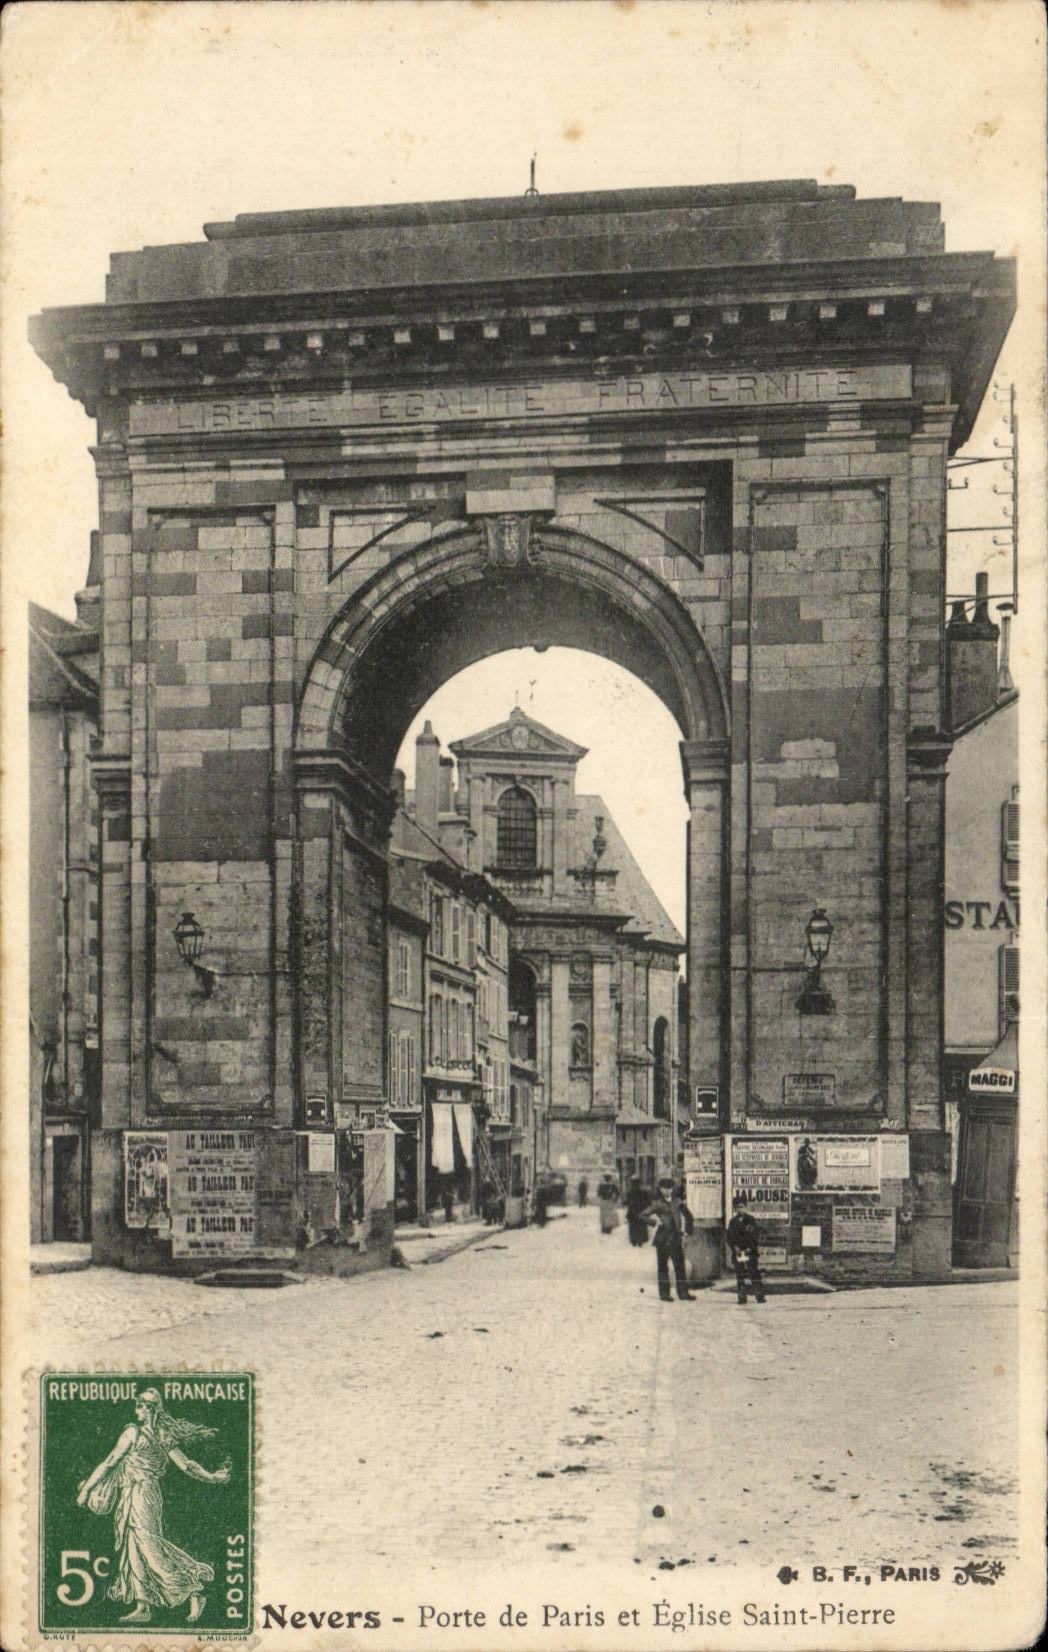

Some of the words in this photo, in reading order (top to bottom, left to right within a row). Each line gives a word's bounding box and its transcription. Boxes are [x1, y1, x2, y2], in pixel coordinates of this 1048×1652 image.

[176, 398, 328, 430] LIBERTE
[378, 386, 546, 419] EGALITE
[596, 370, 859, 407] FRATERNITE
[971, 1073, 1013, 1087] MAGGI
[734, 1189, 789, 1202] JALOUSE
[163, 1381, 246, 1405] FRANÇAISE
[226, 1533, 245, 1619] POSTES
